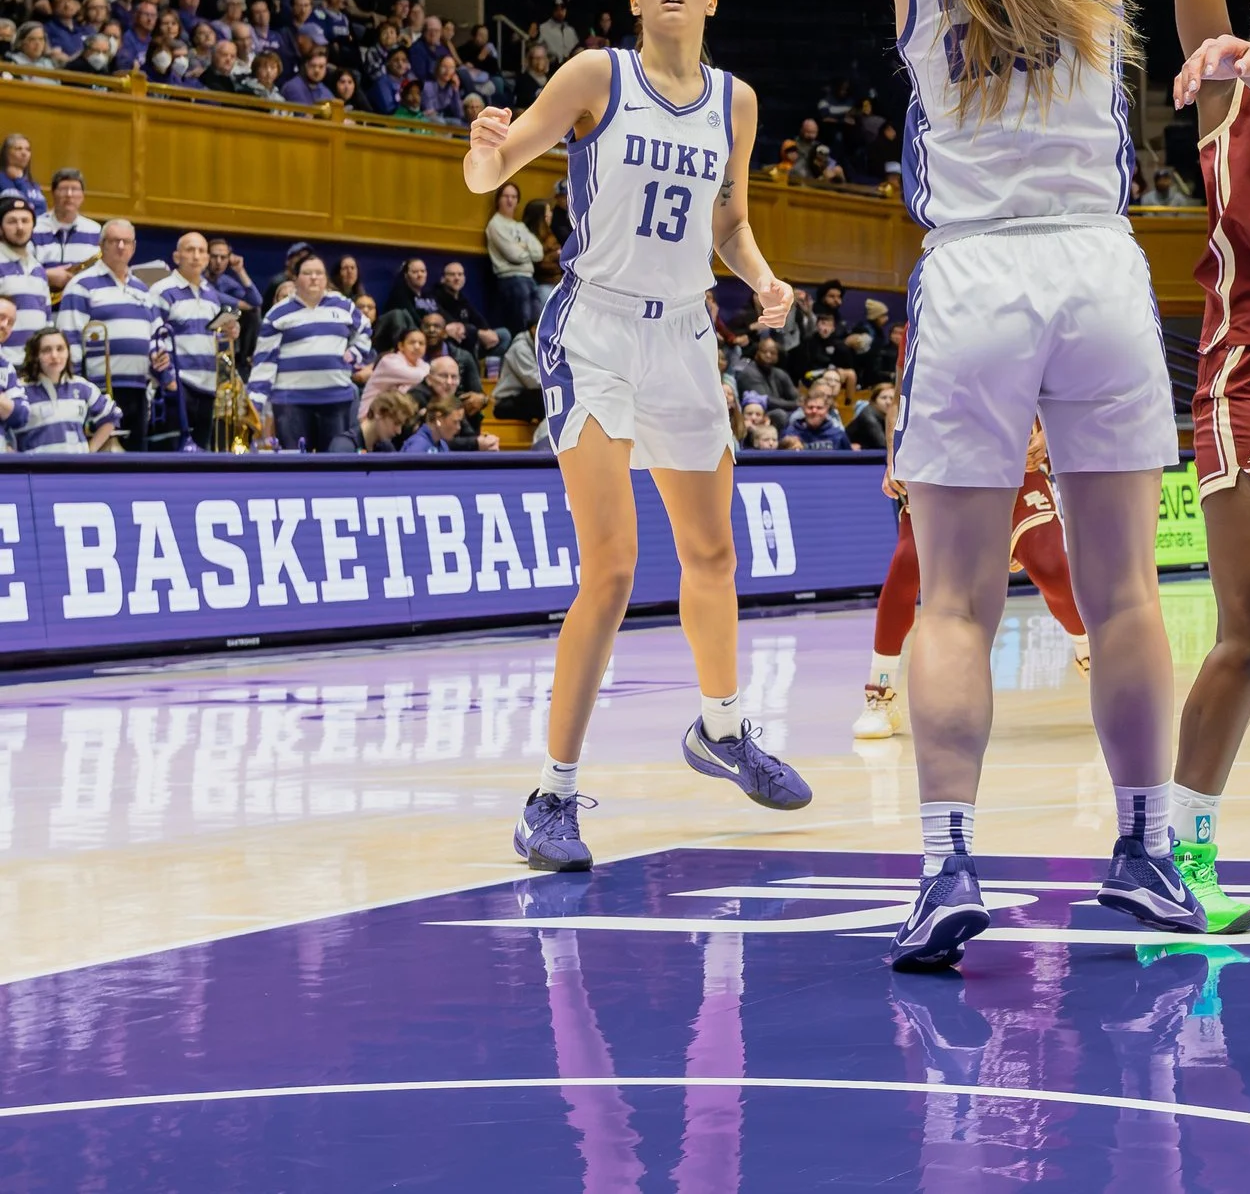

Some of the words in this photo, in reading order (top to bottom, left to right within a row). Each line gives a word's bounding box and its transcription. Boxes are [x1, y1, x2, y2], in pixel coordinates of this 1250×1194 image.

[623, 134, 718, 181] DUKE
[636, 181, 692, 243] 13
[53, 492, 580, 619] BASKETBAL
